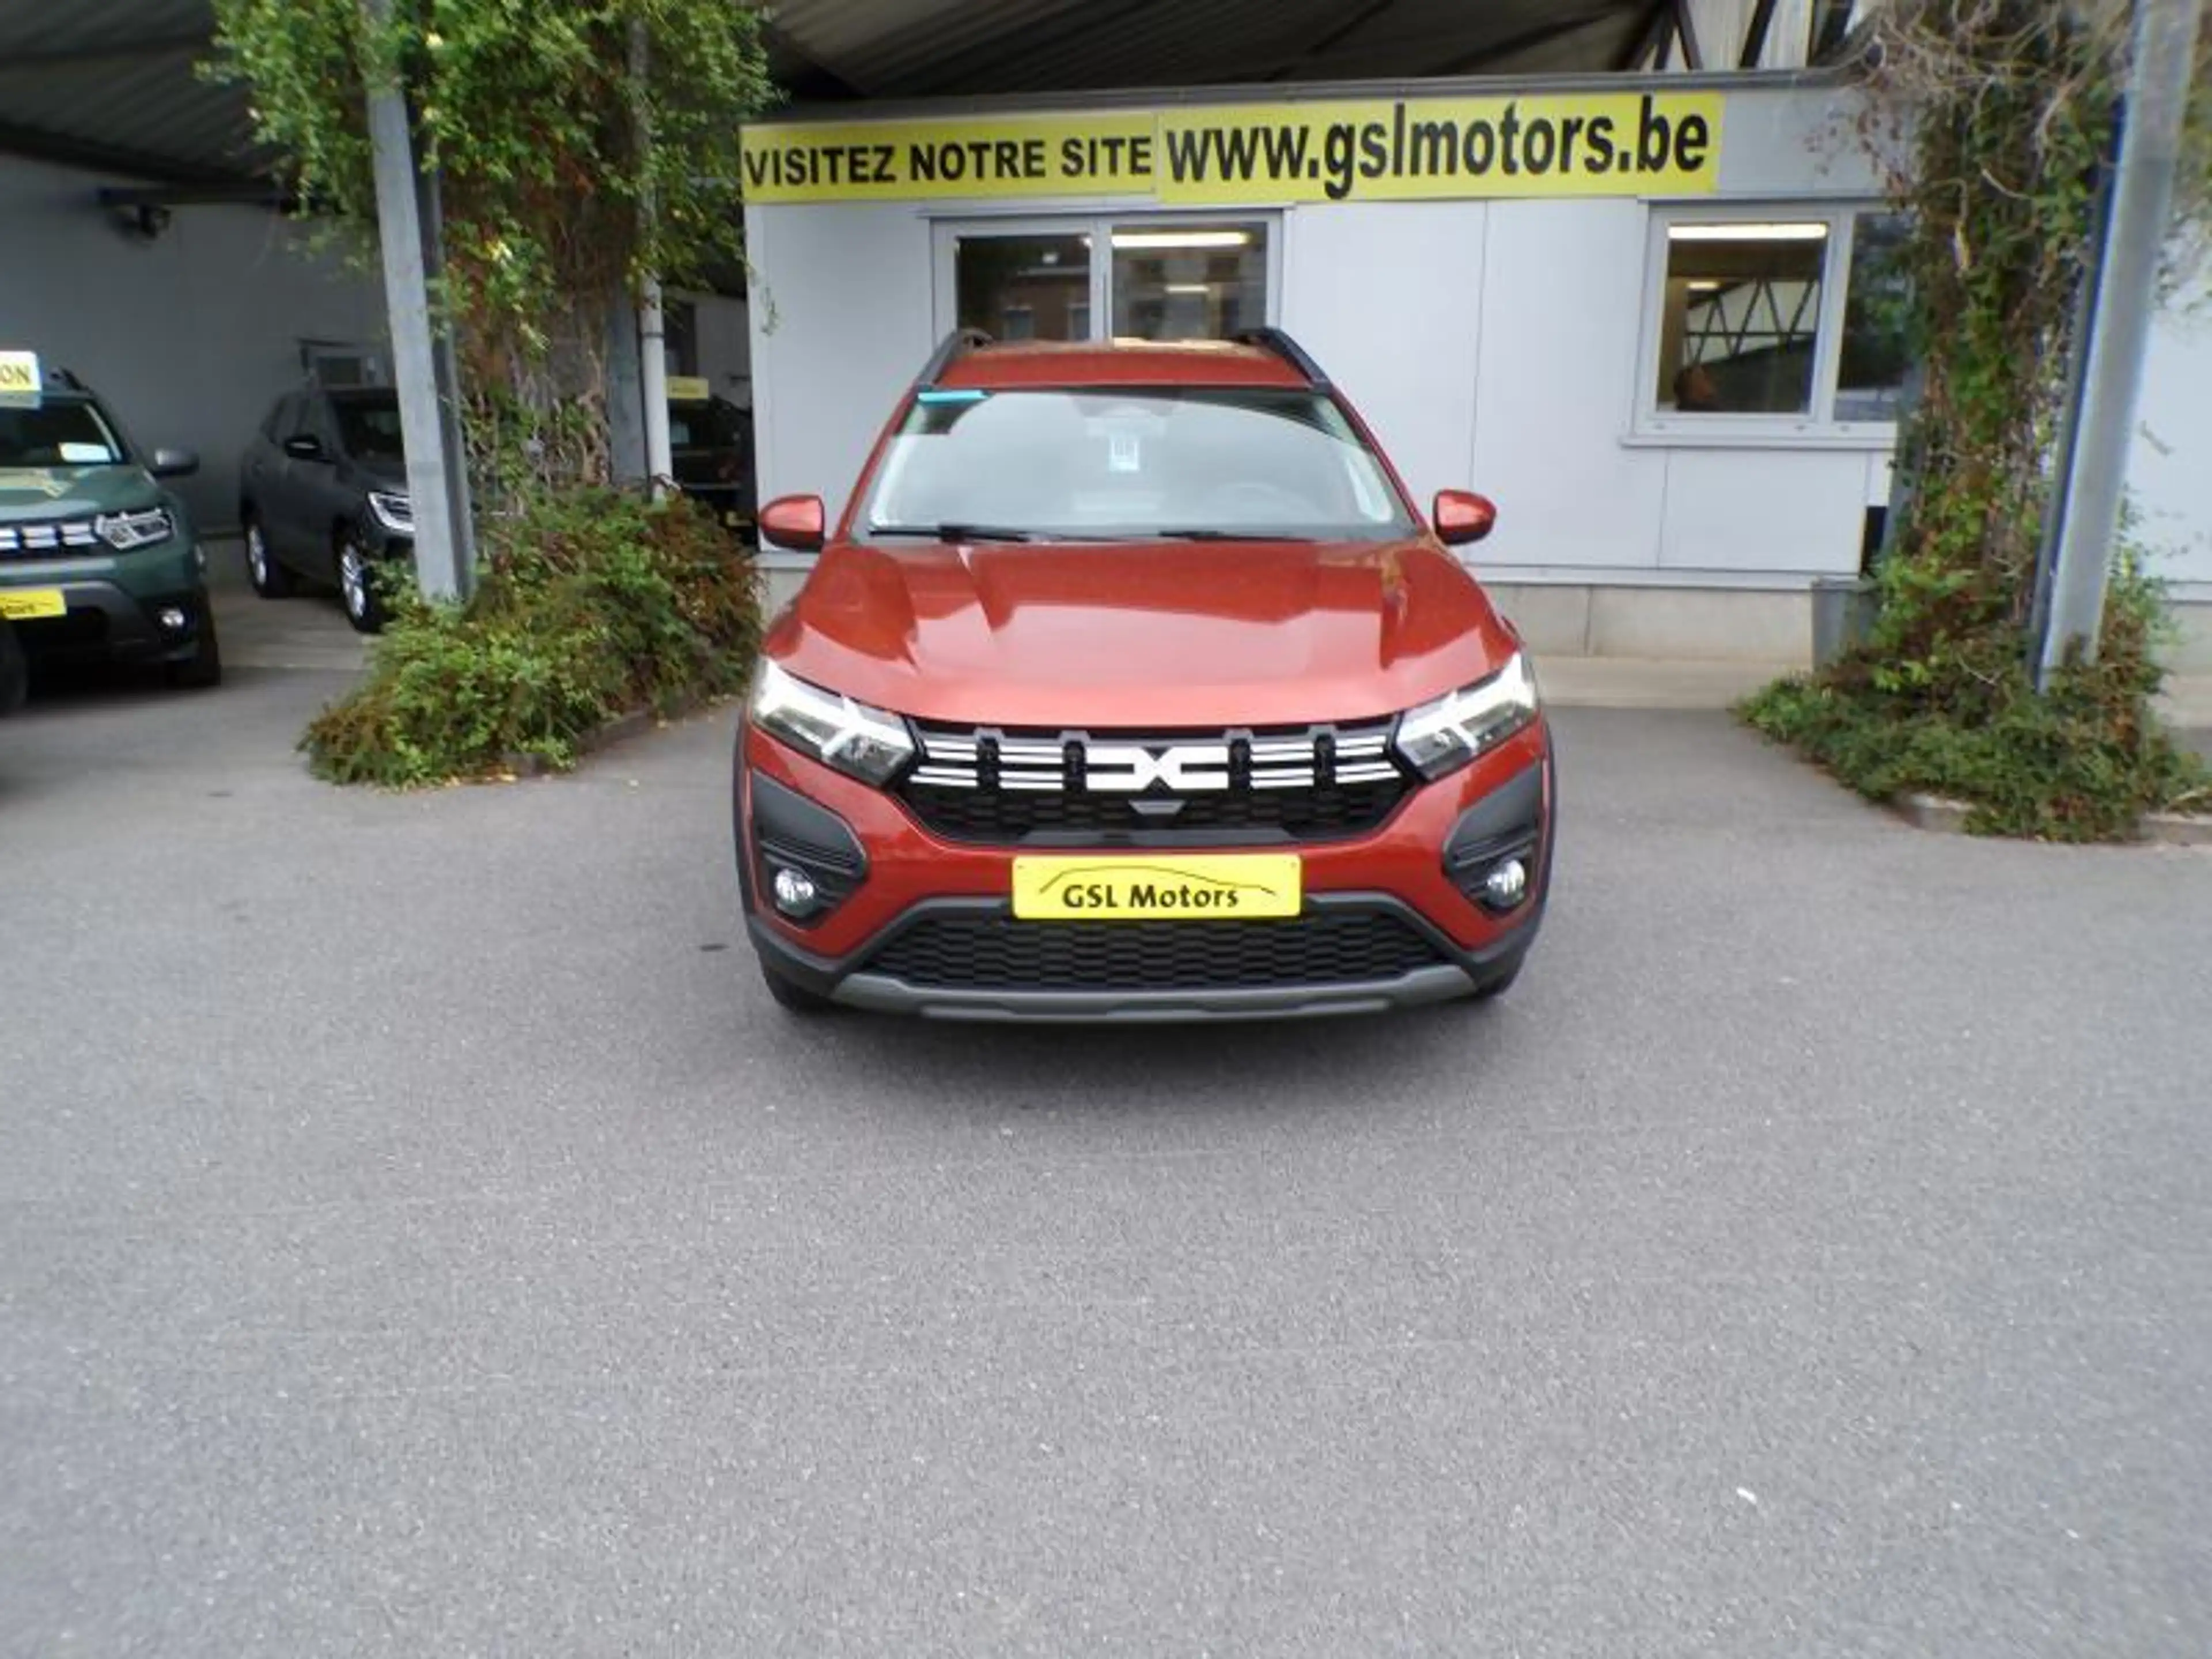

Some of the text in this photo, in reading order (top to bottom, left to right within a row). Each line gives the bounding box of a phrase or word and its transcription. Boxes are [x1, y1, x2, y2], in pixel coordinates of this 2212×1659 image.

[745, 137, 1152, 186] VISITEZ NOTRE SITE
[1166, 94, 1709, 200] www.gslmotors.be
[1062, 884, 1238, 908] GSL Motors
